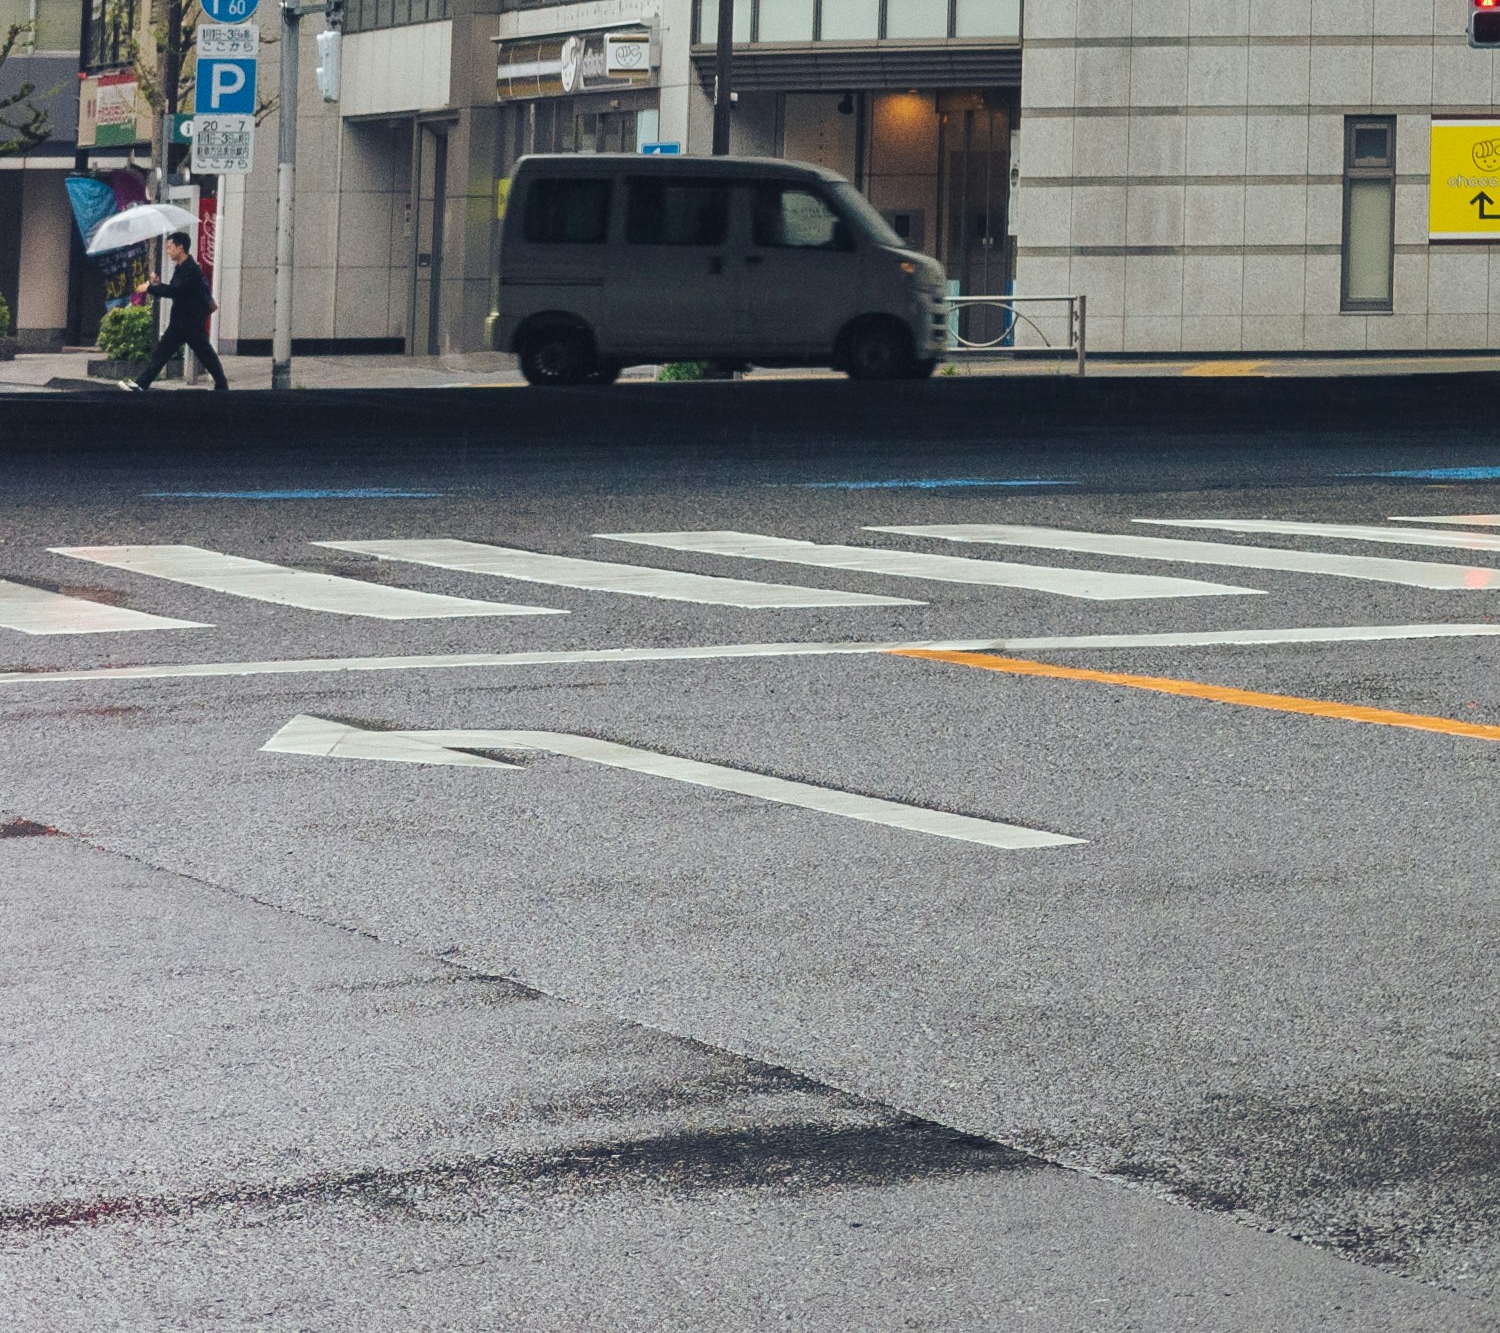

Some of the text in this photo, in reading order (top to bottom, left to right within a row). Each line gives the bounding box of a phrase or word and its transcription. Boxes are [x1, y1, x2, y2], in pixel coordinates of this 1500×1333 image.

[202, 41, 253, 53] ここから
[211, 64, 246, 109] P
[197, 158, 249, 170] ここから
